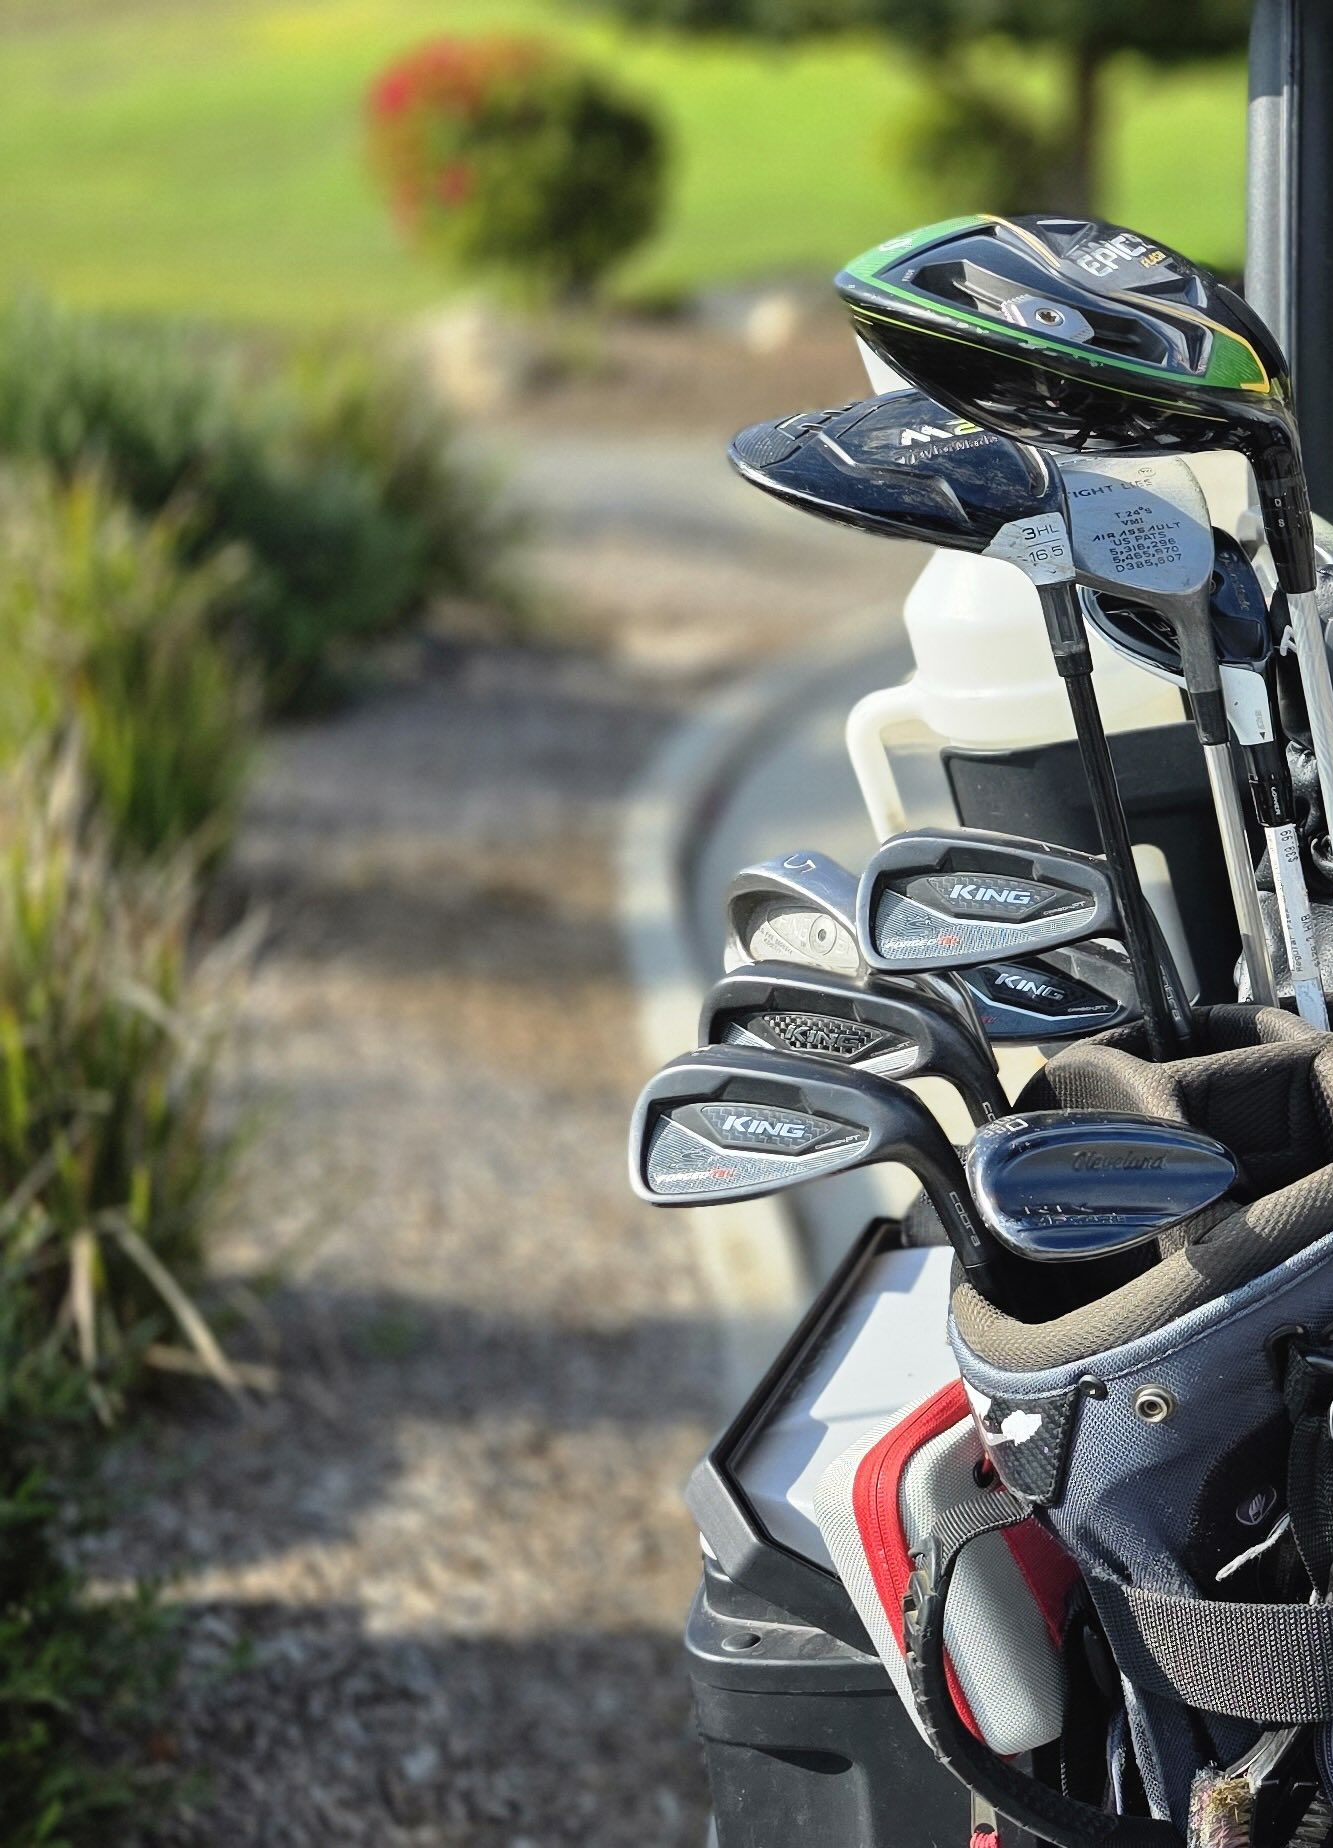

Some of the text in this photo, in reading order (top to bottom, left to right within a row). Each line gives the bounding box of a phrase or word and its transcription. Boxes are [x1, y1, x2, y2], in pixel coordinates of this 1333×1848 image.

[1068, 484, 1113, 499] IGHT
[950, 884, 1032, 905] KING
[994, 972, 1065, 1001] KING
[784, 1023, 860, 1050] KING
[721, 1115, 806, 1139] KING
[1070, 1150, 1167, 1172] Cleveland
[949, 1190, 982, 1238] cobra
